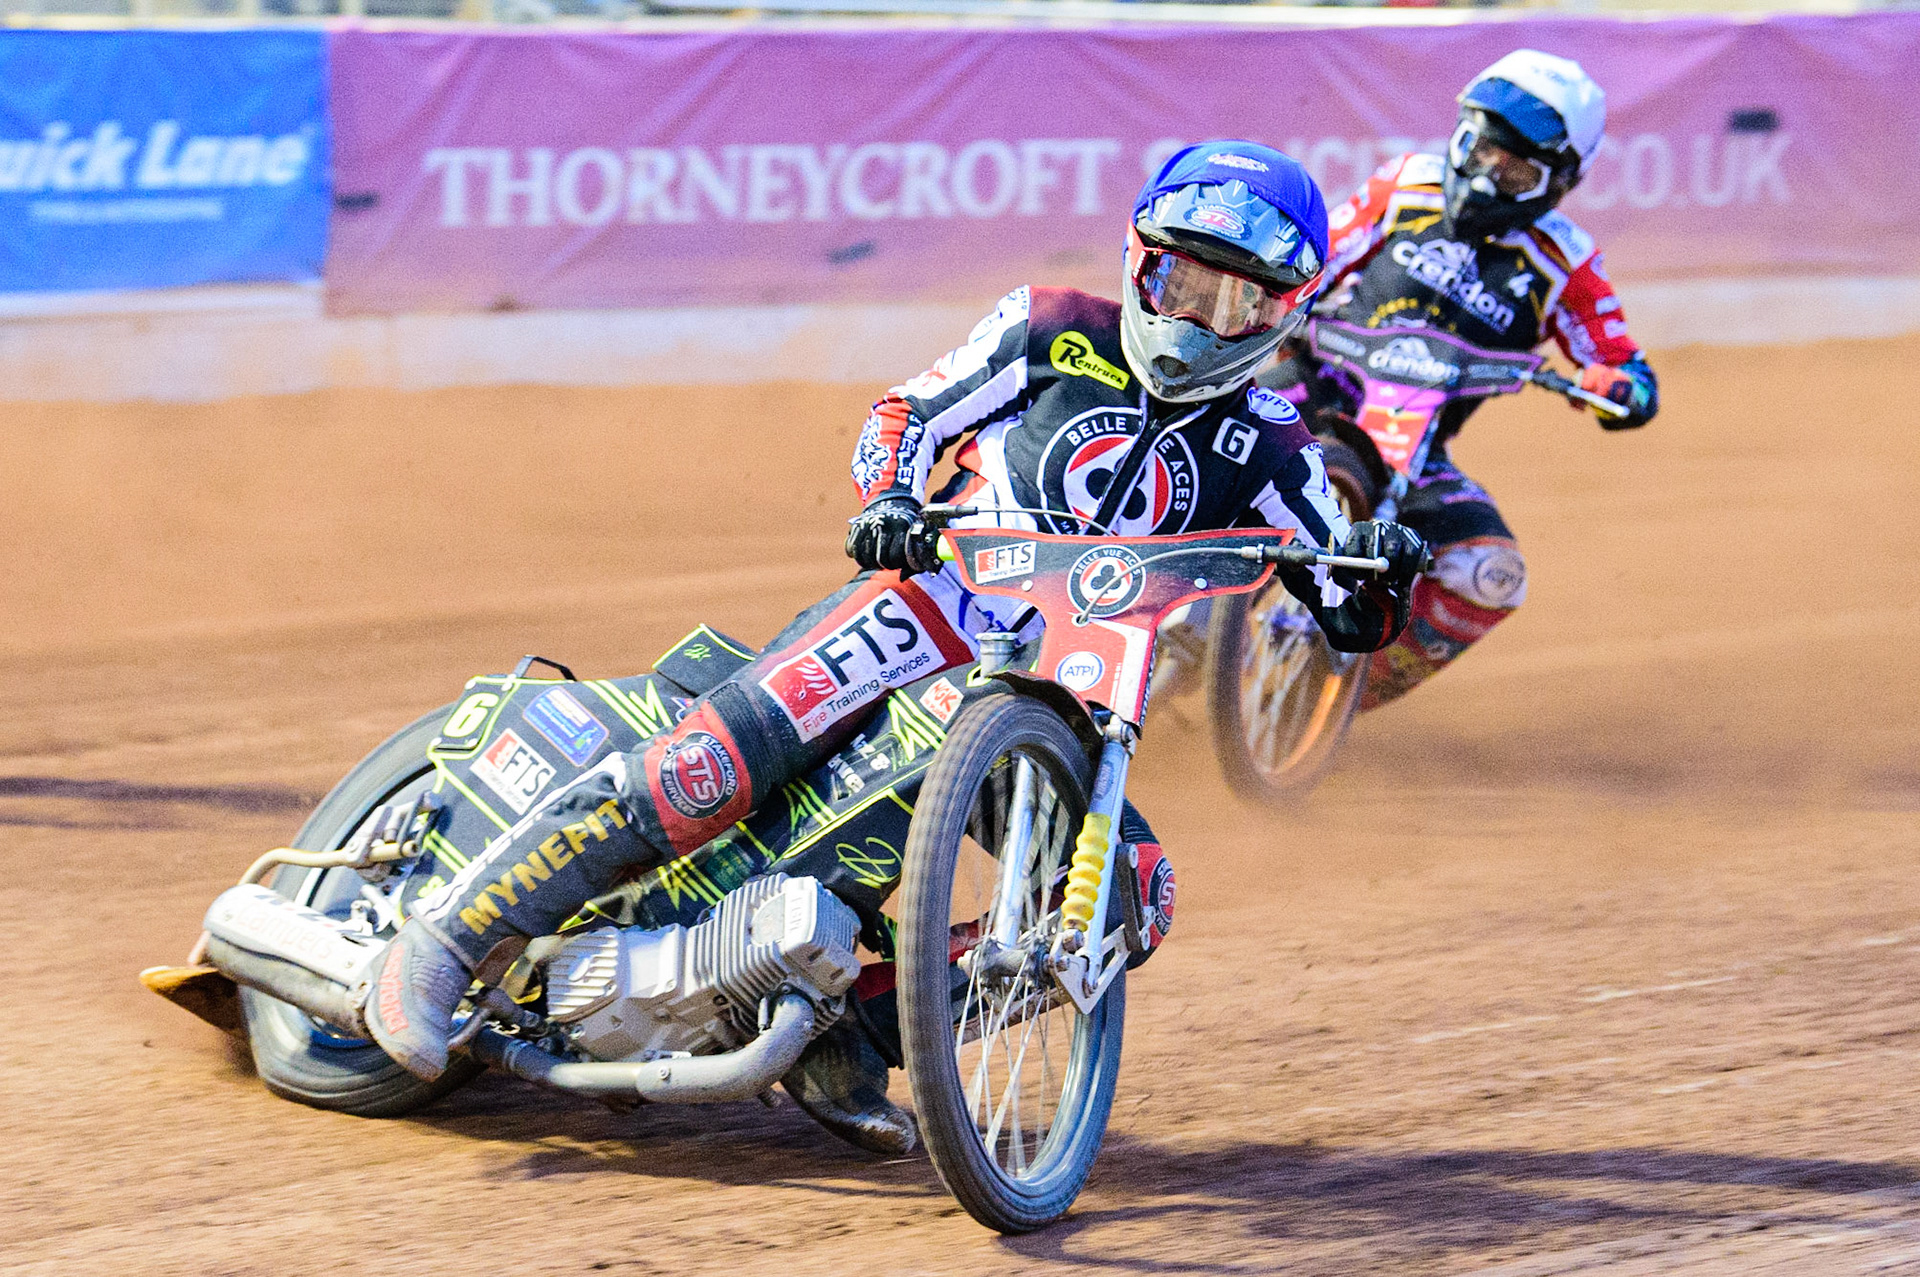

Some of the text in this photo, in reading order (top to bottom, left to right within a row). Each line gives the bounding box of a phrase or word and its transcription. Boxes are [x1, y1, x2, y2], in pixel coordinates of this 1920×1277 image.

[138, 120, 308, 188] Lane
[422, 138, 1121, 228] THORNEYCROFT
[1193, 210, 1239, 231] STS
[1508, 273, 1535, 298] 4
[1058, 338, 1124, 384] Rentruck
[1254, 393, 1292, 413] ATPI
[1065, 416, 1128, 447] BELLE
[1169, 460, 1191, 512] ACES
[996, 544, 1032, 569] FTS
[1074, 549, 1141, 576] BELLE VUE ACS
[813, 598, 919, 687] FTS
[802, 652, 930, 733] Fire Training Services
[1064, 665, 1095, 677] ATPI
[442, 692, 499, 738] 6
[930, 682, 957, 712] NGK
[501, 746, 551, 797] FTS
[681, 745, 720, 801] STS
[699, 735, 737, 796] STAKEFORD
[459, 799, 627, 935] MYNEFIT
